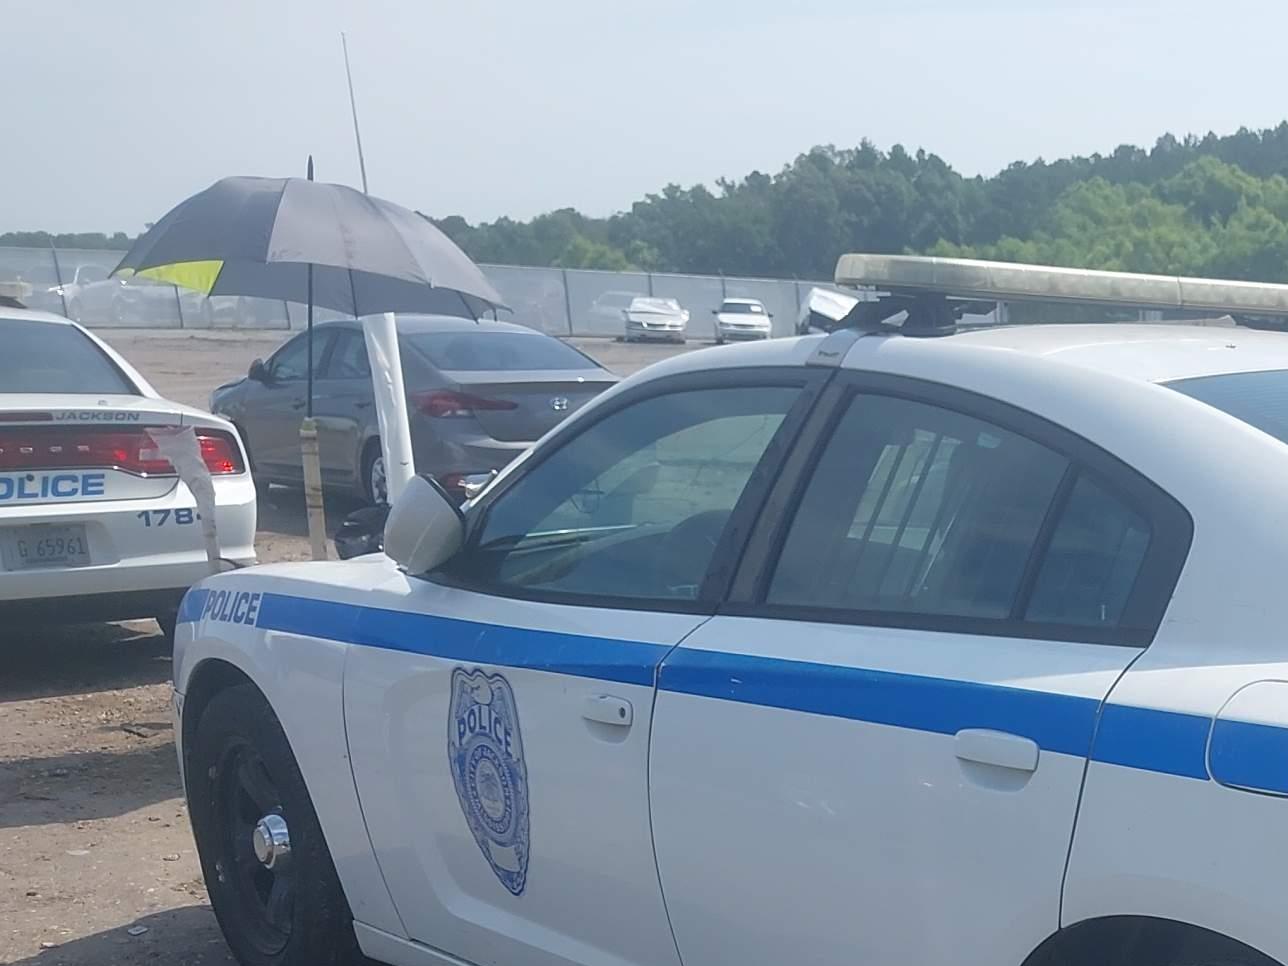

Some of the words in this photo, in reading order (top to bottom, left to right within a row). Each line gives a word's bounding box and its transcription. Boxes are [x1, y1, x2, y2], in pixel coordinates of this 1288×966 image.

[55, 411, 140, 422] JACKSON
[0, 473, 105, 499] OLICE
[37, 536, 86, 557] 65961
[201, 589, 261, 626] POLICE
[457, 703, 514, 761] POLICE
